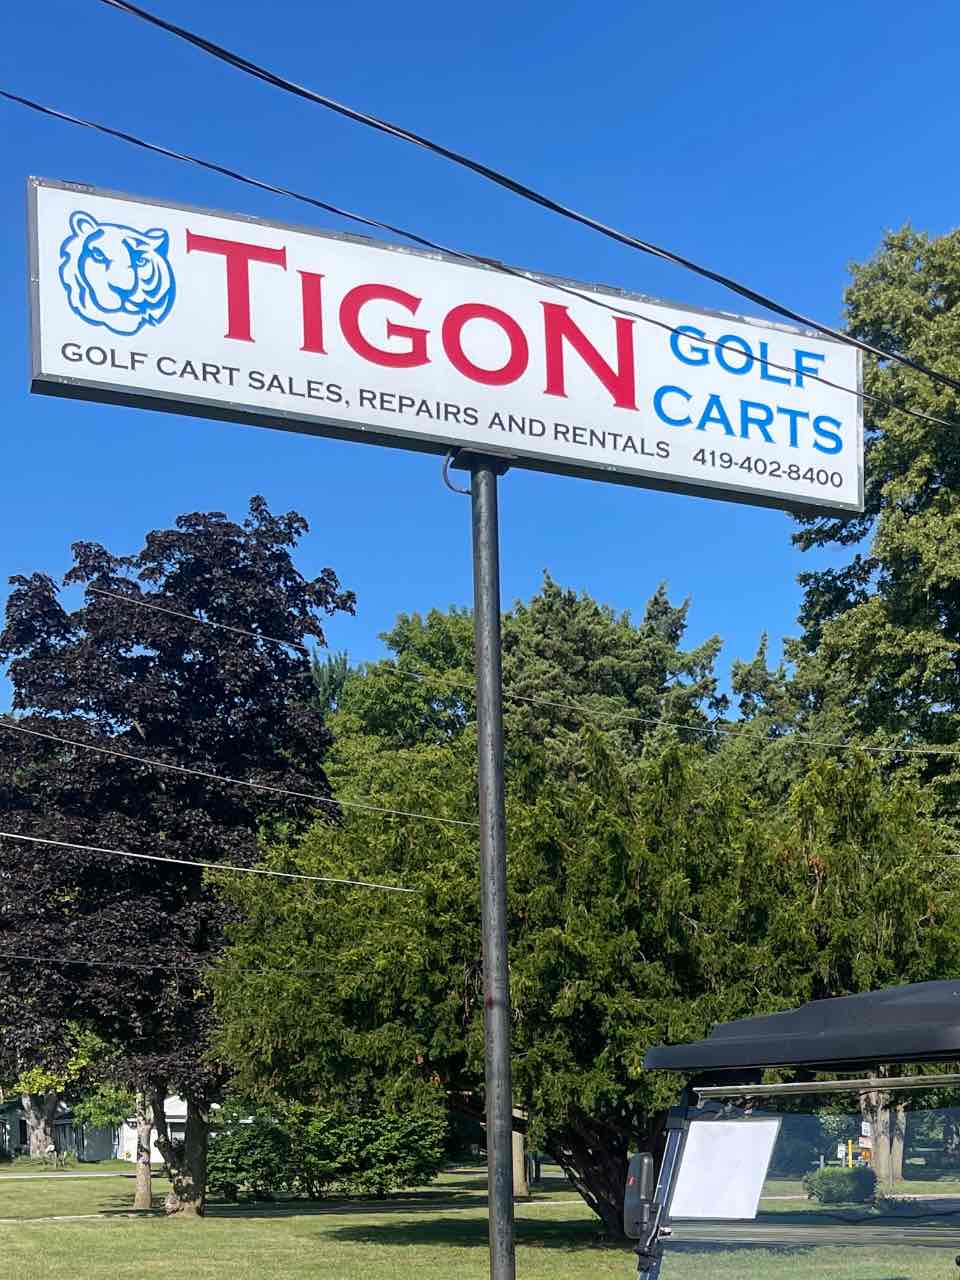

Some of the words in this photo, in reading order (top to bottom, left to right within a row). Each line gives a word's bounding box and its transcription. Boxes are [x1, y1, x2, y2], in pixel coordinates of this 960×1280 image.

[185, 228, 639, 411] TIGON
[669, 324, 825, 389] GOLF
[61, 342, 148, 371] GOLF
[156, 356, 241, 386] CART
[248, 370, 351, 408] SALES,
[359, 388, 479, 426] REPAIRS
[487, 412, 546, 437] AND
[554, 422, 670, 459] RENTALS
[653, 384, 844, 456] CARTS
[692, 448, 844, 488] 419-402-8400
